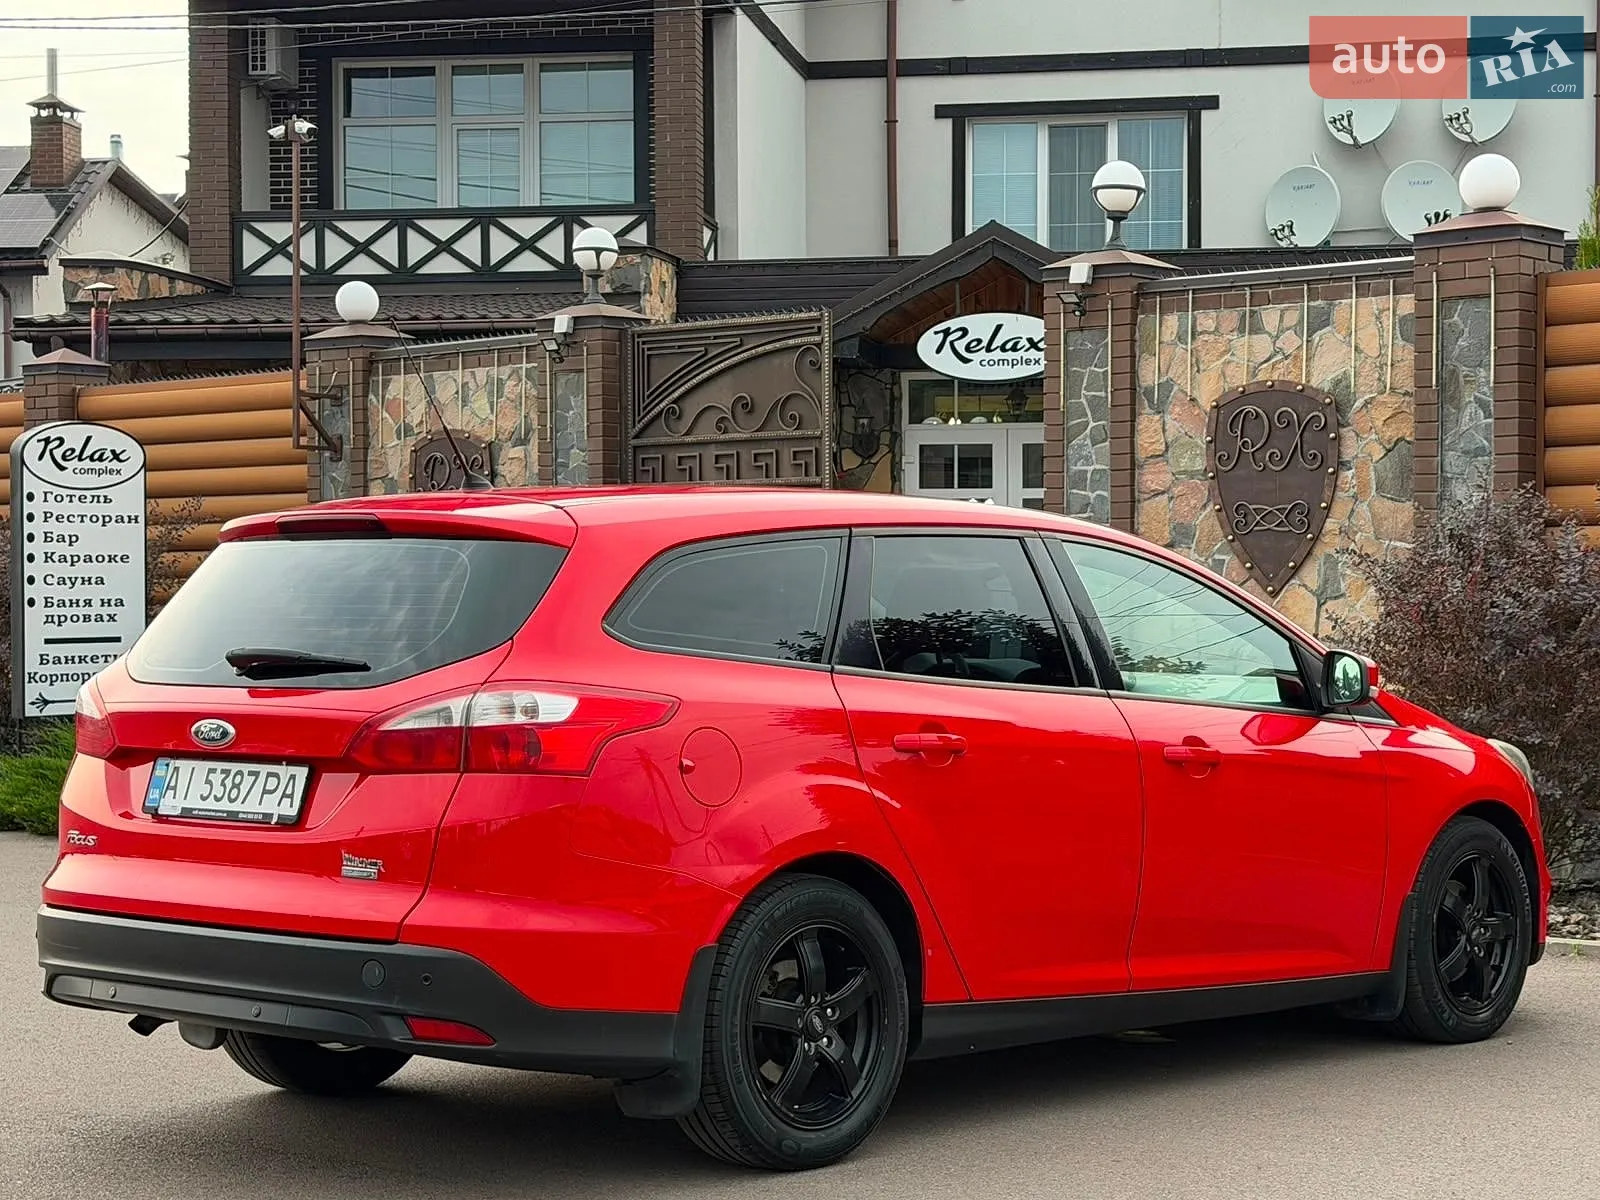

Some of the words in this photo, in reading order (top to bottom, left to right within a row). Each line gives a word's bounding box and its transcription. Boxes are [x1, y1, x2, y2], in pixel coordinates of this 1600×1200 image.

[933, 323, 1044, 364] Relax
[979, 356, 1041, 369] complex
[37, 435, 131, 472] Relax
[72, 466, 122, 477] complex
[42, 491, 113, 504] Готель
[42, 511, 140, 527] Ресторан
[42, 531, 79, 546] Бар
[43, 551, 130, 567] Караоке
[43, 574, 105, 589] Сауна
[43, 596, 93, 608] Баня
[100, 597, 125, 608] на
[43, 613, 118, 627] дровах
[27, 671, 97, 686] Корпор
[198, 723, 224, 739] Ford
